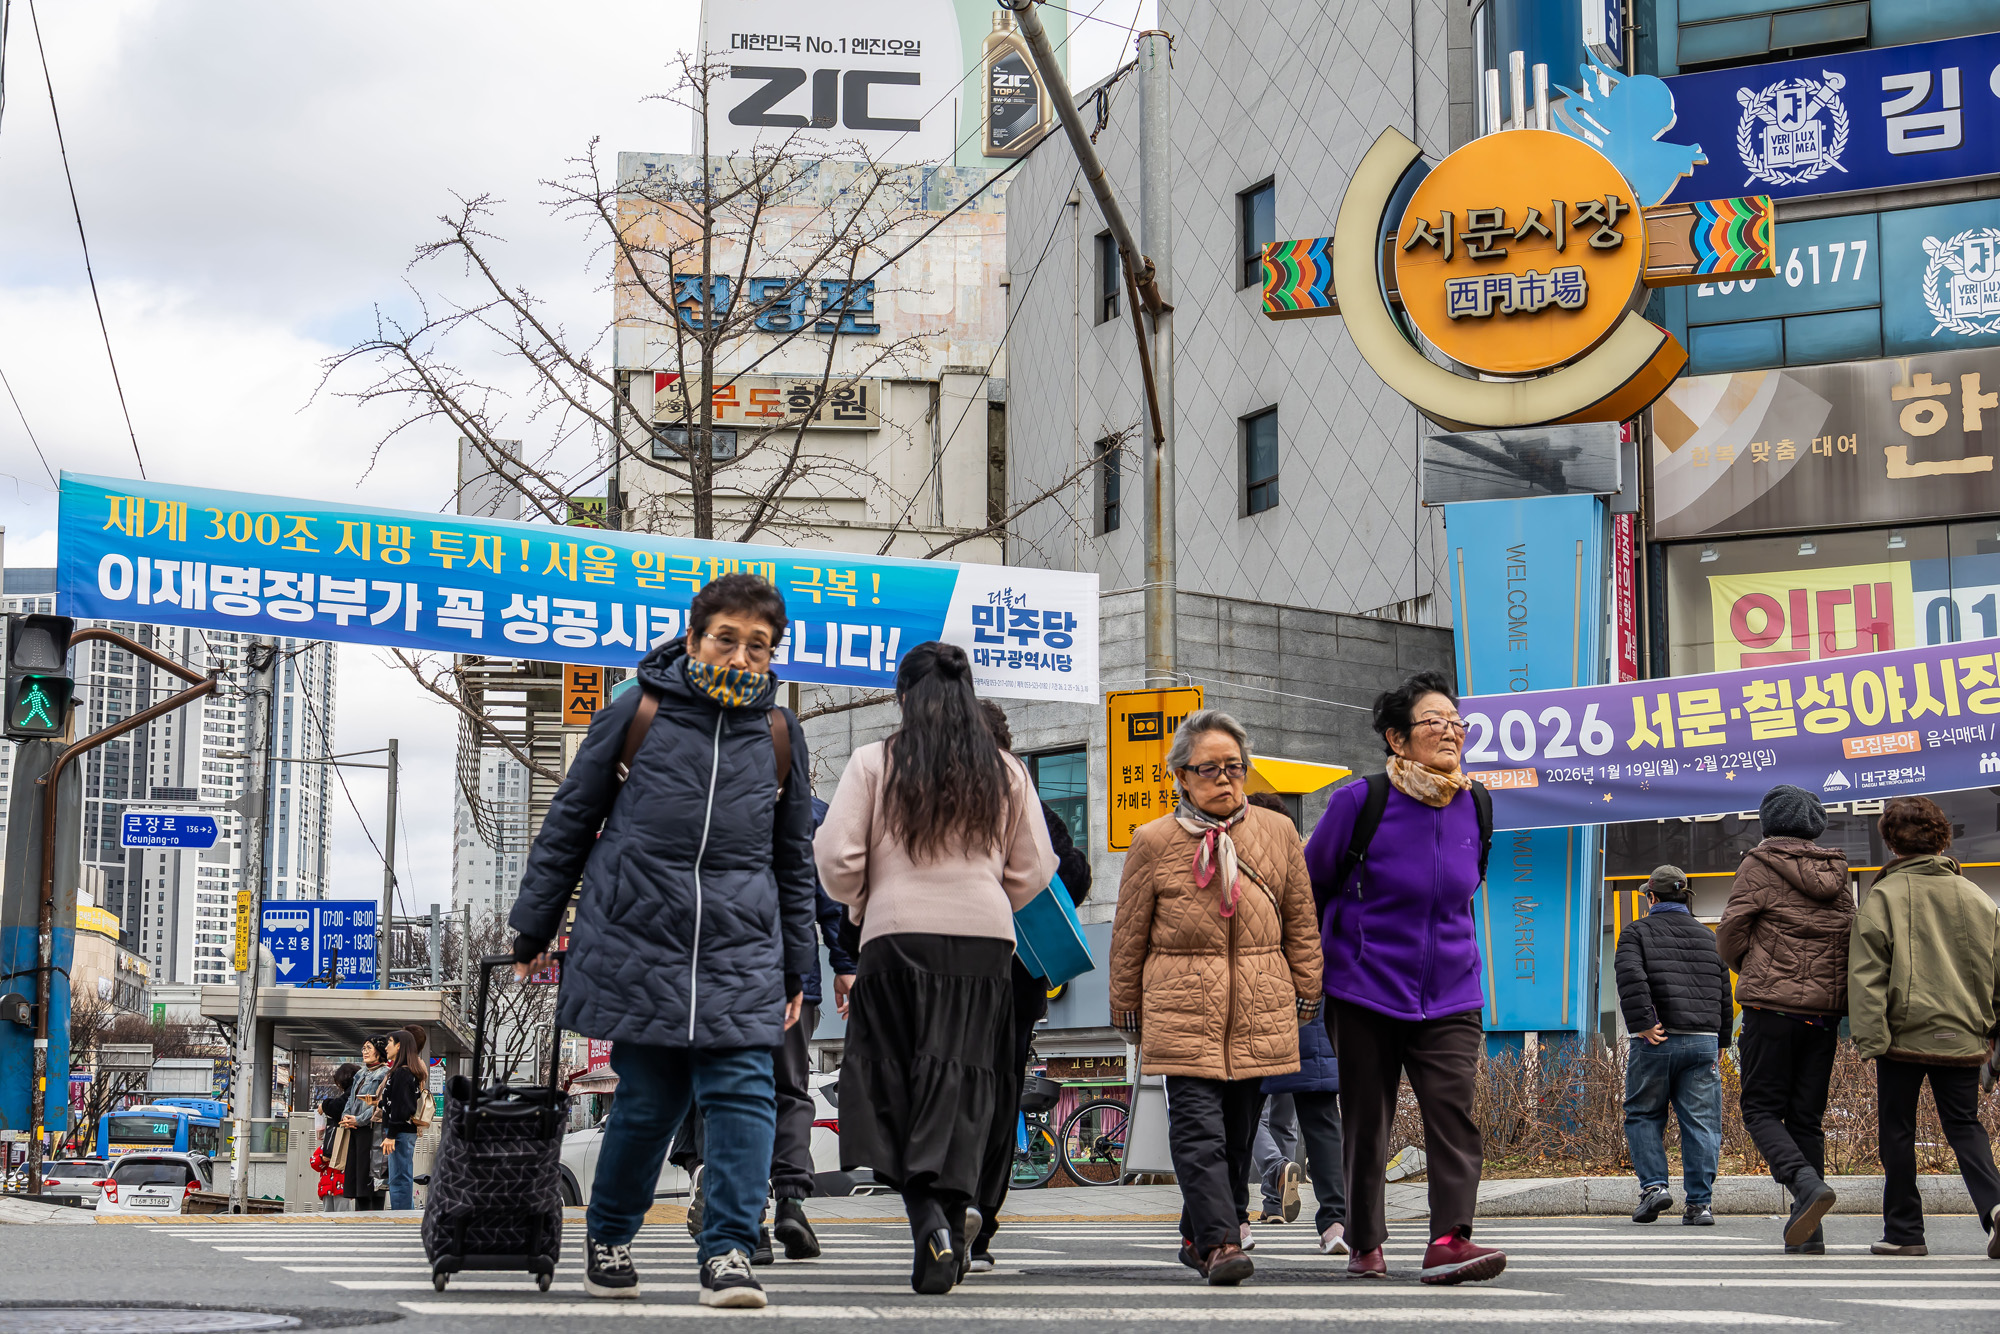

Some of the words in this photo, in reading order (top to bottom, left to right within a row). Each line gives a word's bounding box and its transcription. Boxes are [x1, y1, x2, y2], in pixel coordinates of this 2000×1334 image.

[731, 33, 801, 52] 대한민국
[806, 36, 847, 53] No.1
[852, 37, 921, 57] 엔진오일
[993, 74, 1030, 87] ZIC
[728, 65, 921, 132] ZIC
[1881, 63, 2000, 156] 김
[1770, 134, 1790, 146] VERI
[1795, 130, 1815, 142] LUX
[1772, 145, 1790, 156] TAS
[1795, 142, 1816, 153] MEA
[1402, 194, 1630, 263] 서문시장
[1449, 271, 1582, 314] 西門市場
[1957, 282, 1978, 294] VERI
[1960, 294, 1978, 306] TAS
[1884, 372, 1999, 479] 한
[1691, 444, 1735, 467] 한복
[1751, 439, 1797, 463] 맞춤
[1812, 433, 1857, 457] 대여
[103, 494, 187, 542] 재계
[204, 507, 320, 553] 300조
[334, 520, 415, 565] 지방
[429, 529, 506, 574] 투자
[520, 539, 529, 572] !
[542, 542, 617, 585] 서울
[790, 566, 858, 607] 극복
[872, 573, 880, 604] !
[98, 553, 422, 632] 이재명정부가
[437, 587, 484, 639] 꼭
[987, 587, 1026, 609] 더불어
[1507, 544, 1529, 652] WELCOME
[972, 605, 1077, 649] 민주당
[1730, 582, 1896, 668] 임대
[973, 648, 1072, 672] 대구광역시당
[1463, 702, 1614, 764] 2026
[1850, 733, 1915, 755] 모집분야
[1926, 724, 1986, 748] 음식매대
[1122, 764, 1144, 784] 범죄
[1547, 766, 1594, 782] 2026년
[1599, 764, 1620, 779] 1월
[1625, 758, 1679, 777] 19일(월)
[1695, 755, 1718, 772] 2월
[1721, 749, 1777, 768] 22일(일)
[1861, 766, 1926, 783] 대구광역시
[1117, 790, 1151, 810] 카메라
[127, 817, 176, 833] 큰장로
[127, 834, 179, 845] Keunjang-ro
[323, 911, 343, 926] 07:00
[353, 911, 373, 926] 09:00
[323, 934, 343, 950] 17:30
[353, 934, 373, 950] 19:30
[1514, 895, 1535, 985] MARKET
[359, 957, 373, 974] 제외
[153, 1124, 169, 1134] 240
